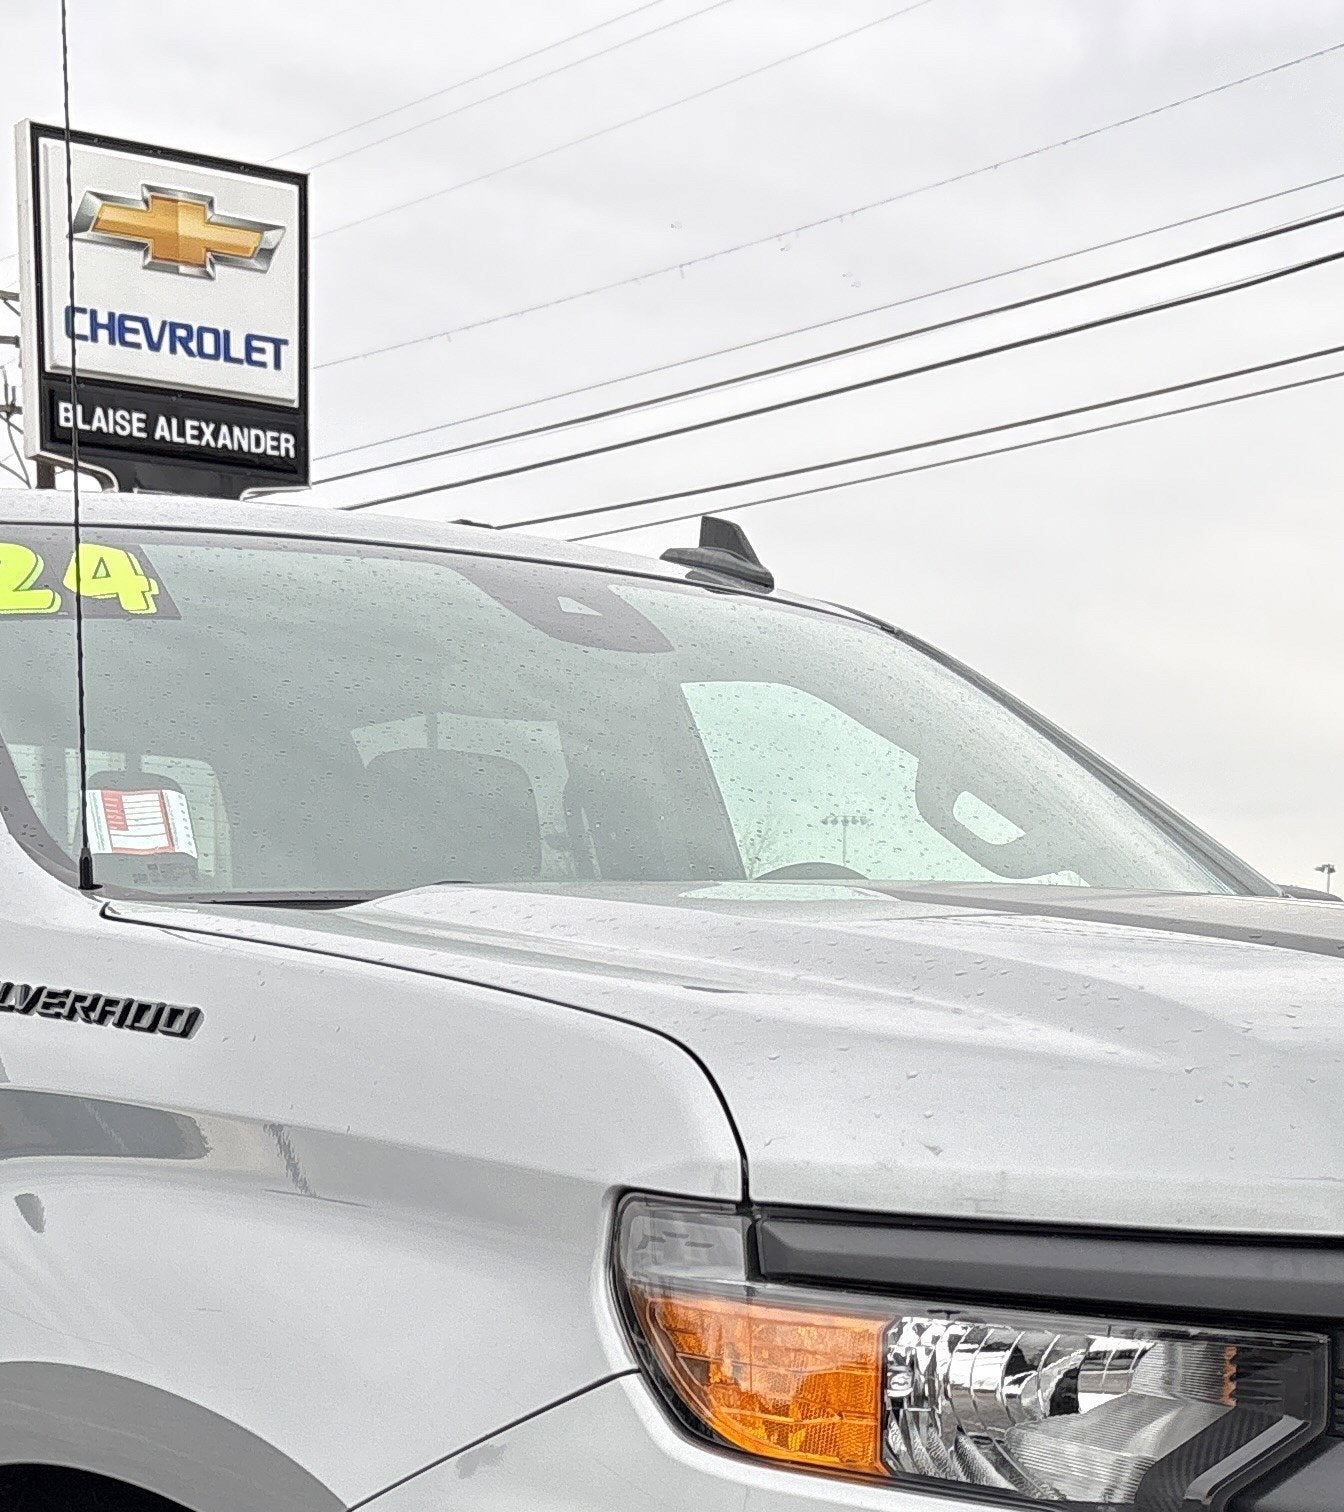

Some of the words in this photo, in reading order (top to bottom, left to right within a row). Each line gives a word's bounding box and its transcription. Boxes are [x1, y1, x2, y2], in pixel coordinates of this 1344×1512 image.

[64, 305, 289, 371] CHEVROLET
[58, 402, 148, 438] BLAISE
[154, 415, 296, 459] ALEXANDER
